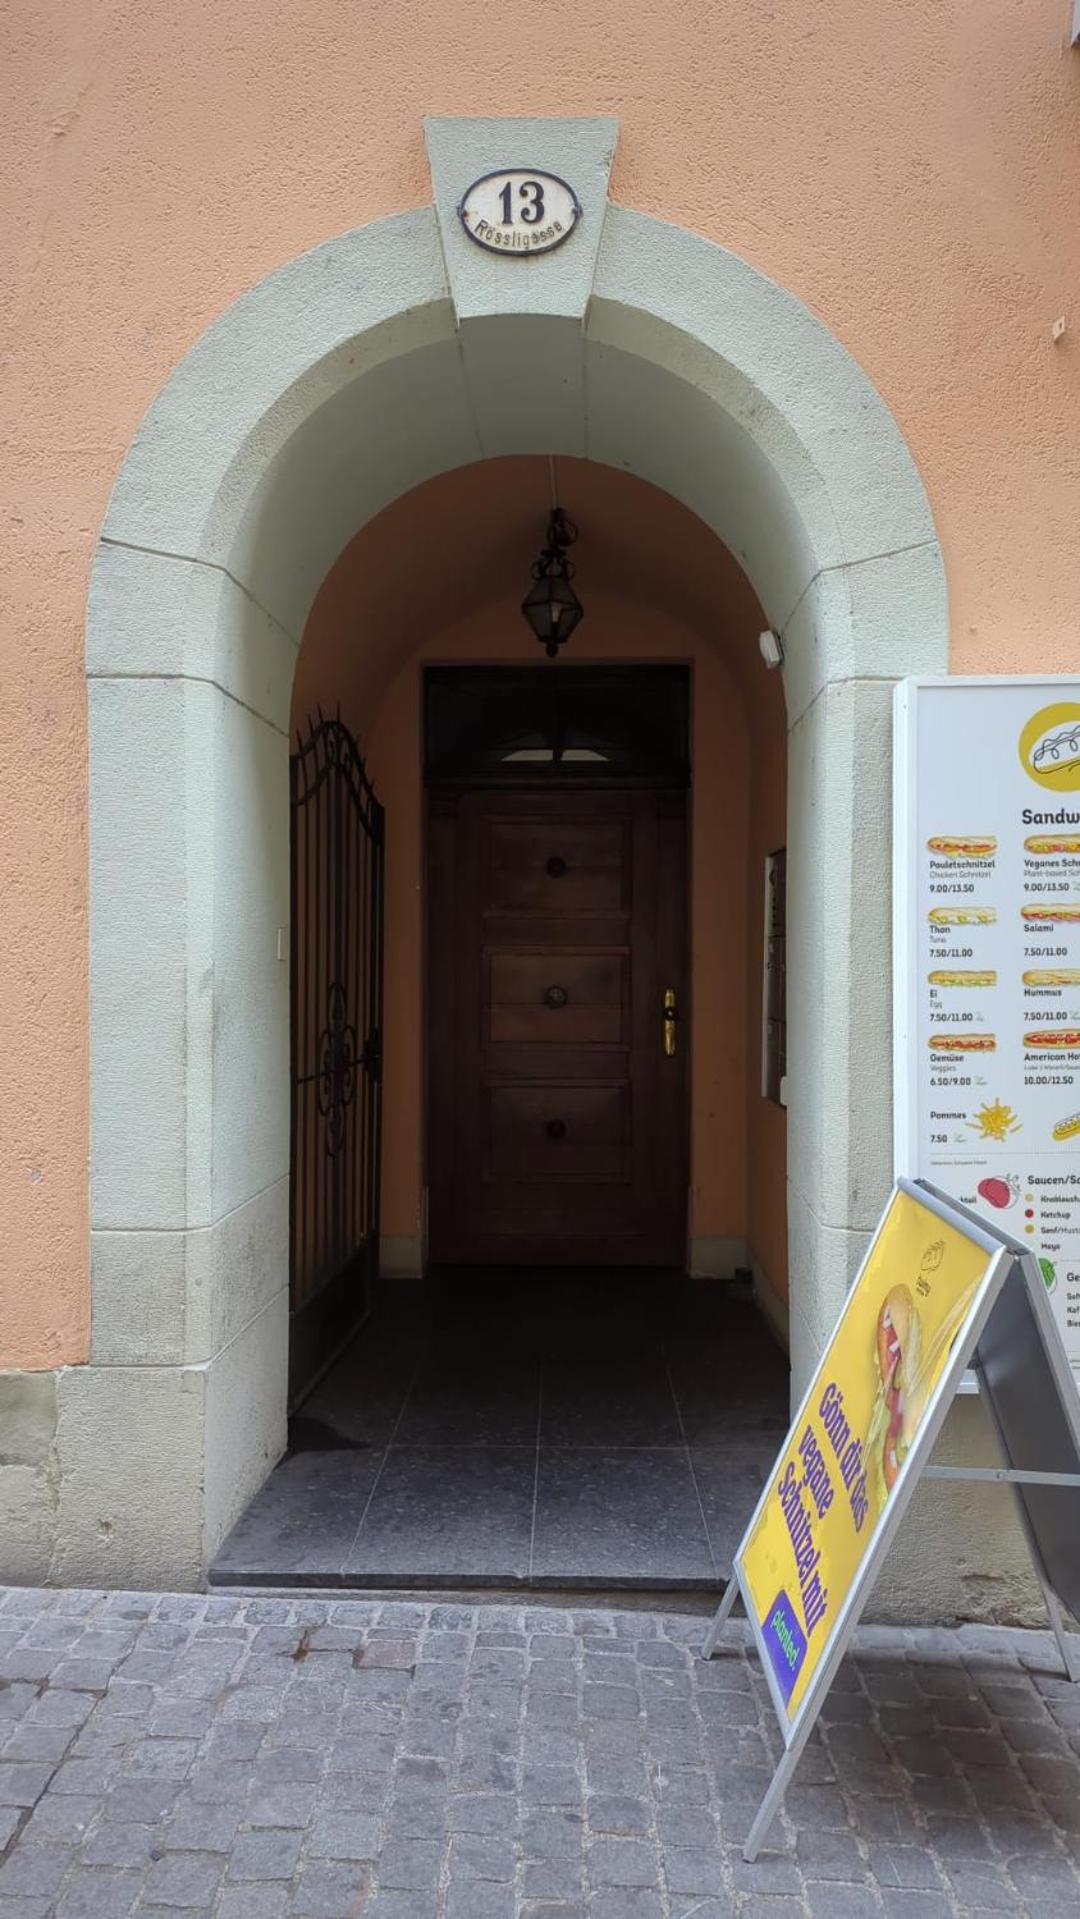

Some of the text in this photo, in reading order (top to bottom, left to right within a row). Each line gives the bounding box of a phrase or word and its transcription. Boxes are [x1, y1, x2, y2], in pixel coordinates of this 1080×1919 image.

[499, 181, 545, 225] 13
[474, 219, 563, 251] Rössligasse
[929, 861, 995, 869] Pouletschnitzel
[1024, 860, 1060, 869] Veganes
[929, 884, 975, 893] 9.00/13.50
[1024, 883, 1070, 892] 9.00/13.50
[929, 925, 951, 934] Thon
[1024, 924, 1054, 932] Salami
[929, 949, 974, 958] 7.50/11.00
[1024, 948, 1068, 957] 7.50/11.00
[1024, 989, 1062, 997] Hummus
[929, 1013, 974, 1022] 7.50/11.00
[1024, 1012, 1068, 1021] 7.50/11.00
[1024, 1053, 1066, 1061] American
[929, 1077, 972, 1086] 6.50/9.00
[1024, 1076, 1074, 1085] 10.00/12.50
[930, 1111, 967, 1120] Pommes
[930, 1134, 948, 1143] 7.50
[1041, 1211, 1071, 1220] Ketchup
[819, 1382, 869, 1533] Gönn dir das
[798, 1425, 834, 1519] vegane
[778, 1461, 828, 1638] Schnitzel mir
